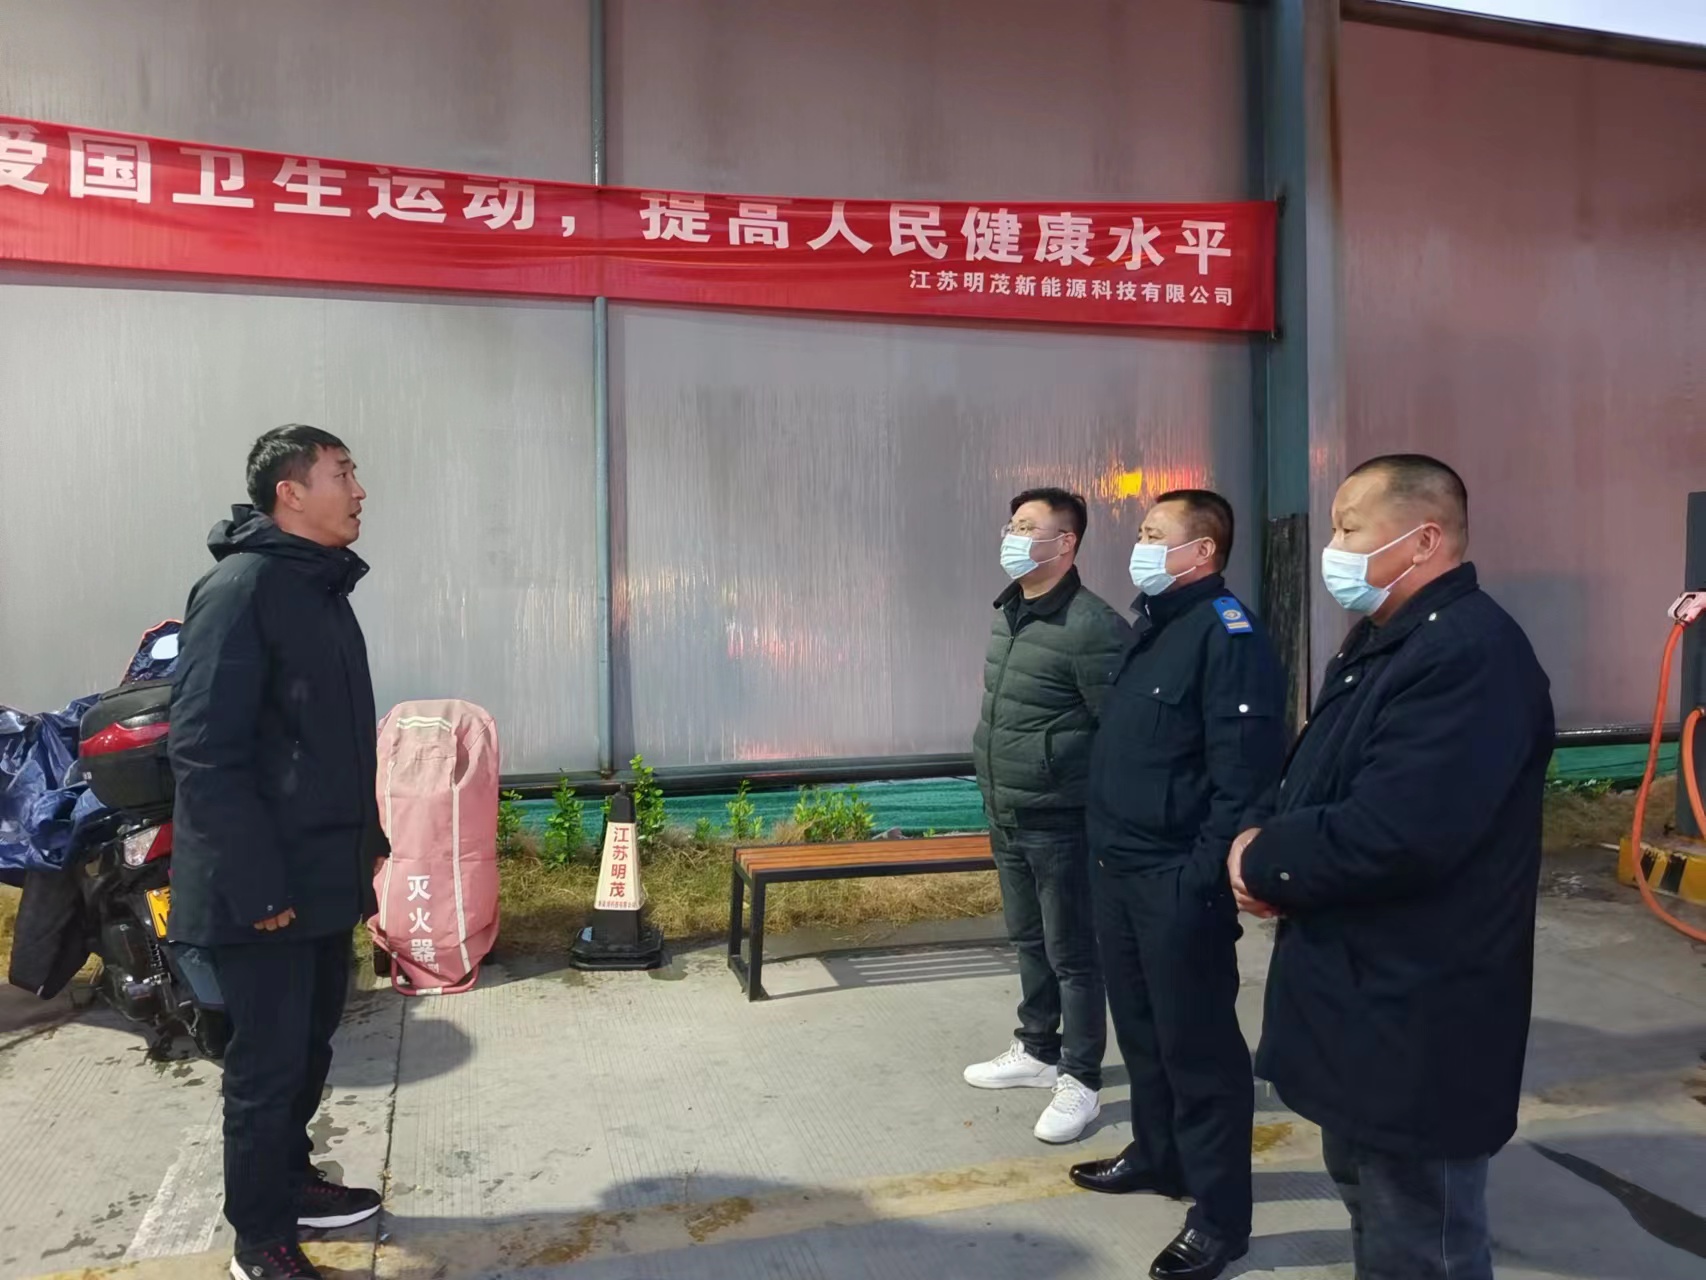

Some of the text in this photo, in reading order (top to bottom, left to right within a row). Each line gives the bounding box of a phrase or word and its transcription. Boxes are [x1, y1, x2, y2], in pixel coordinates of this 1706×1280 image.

[909, 269, 1233, 306] 江苏明茂新能源科技有限公司
[609, 826, 630, 898] 江苏明茂
[407, 875, 437, 963] 灭火器
